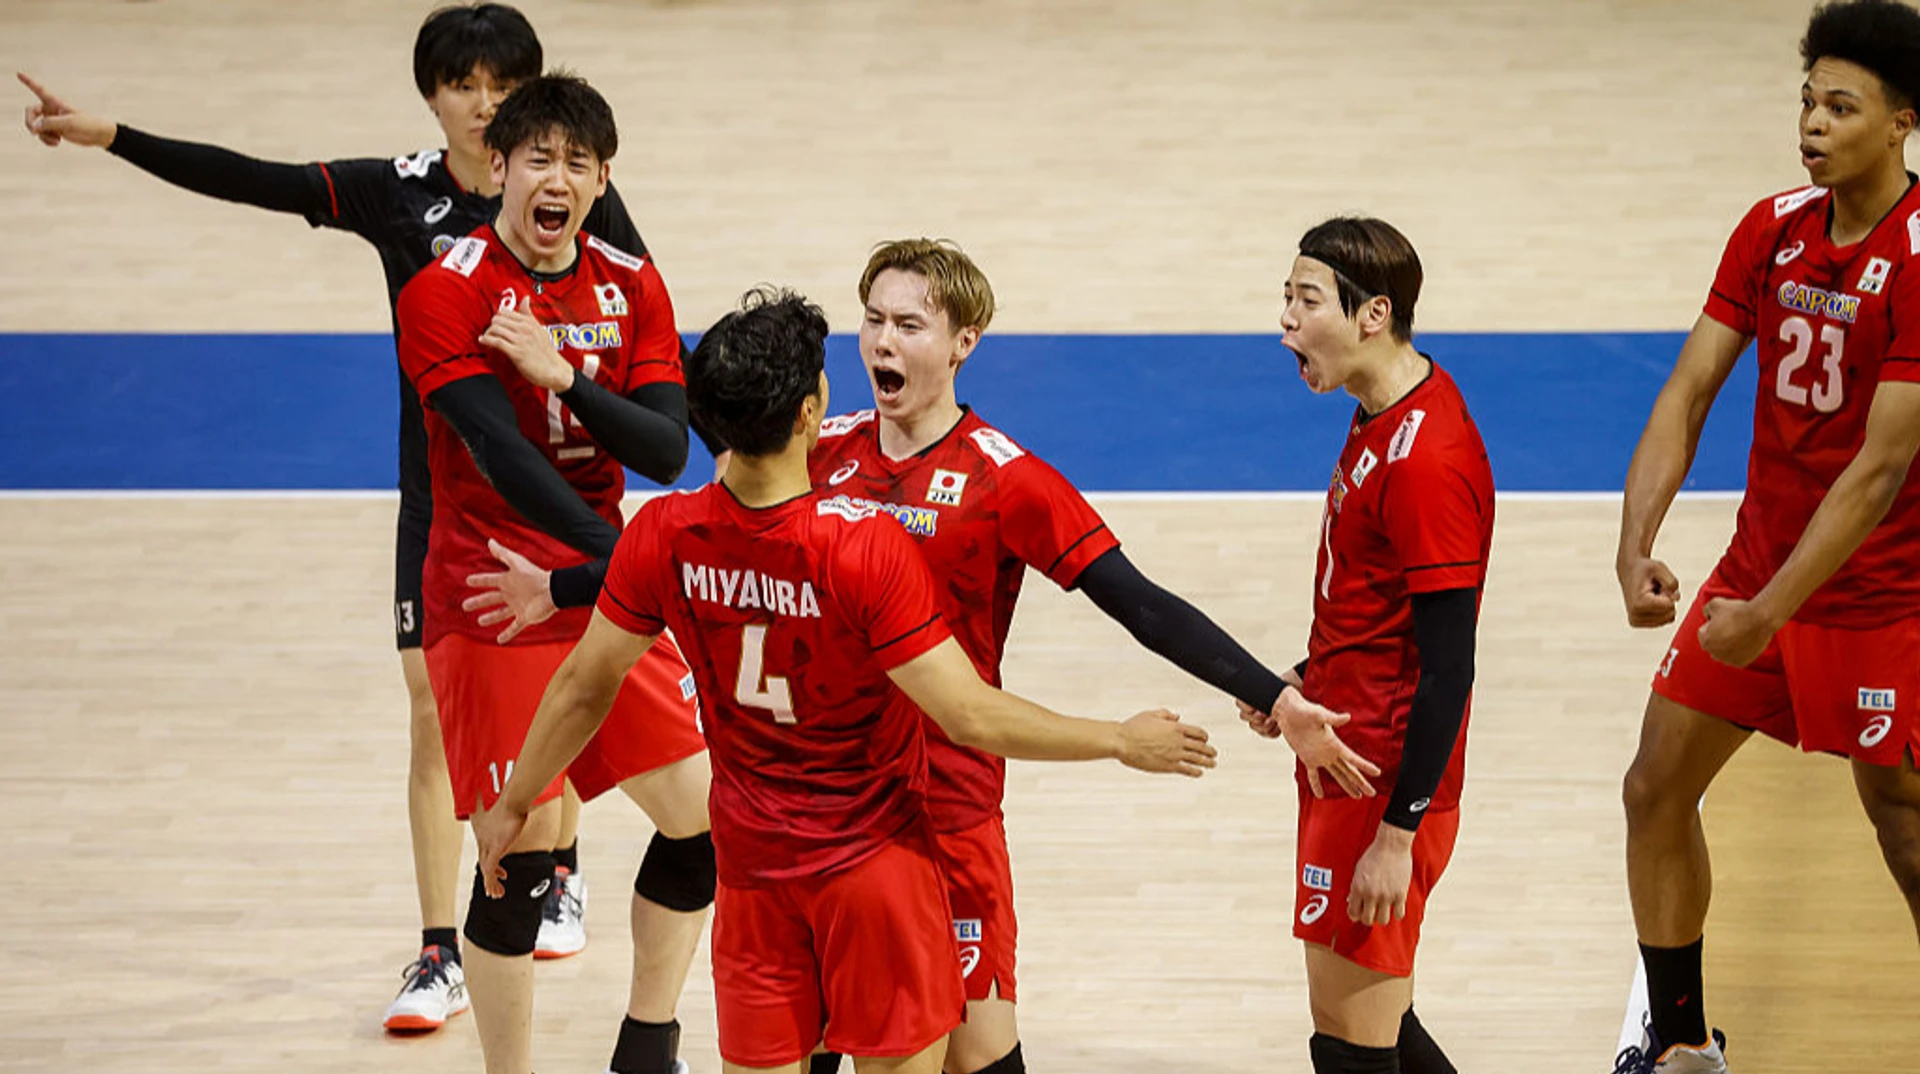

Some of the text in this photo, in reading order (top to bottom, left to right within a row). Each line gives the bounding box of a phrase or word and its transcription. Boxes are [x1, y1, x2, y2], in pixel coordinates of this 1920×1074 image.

[1779, 281, 1861, 324] CAPCOM
[549, 321, 622, 349] PCOM
[1777, 317, 1844, 411] 23
[931, 492, 955, 504] JPN
[682, 561, 822, 618] MIYAURA
[735, 624, 797, 725] 4
[1660, 648, 1679, 678] 3
[1860, 691, 1893, 708] TEL
[1305, 867, 1330, 888] TEL
